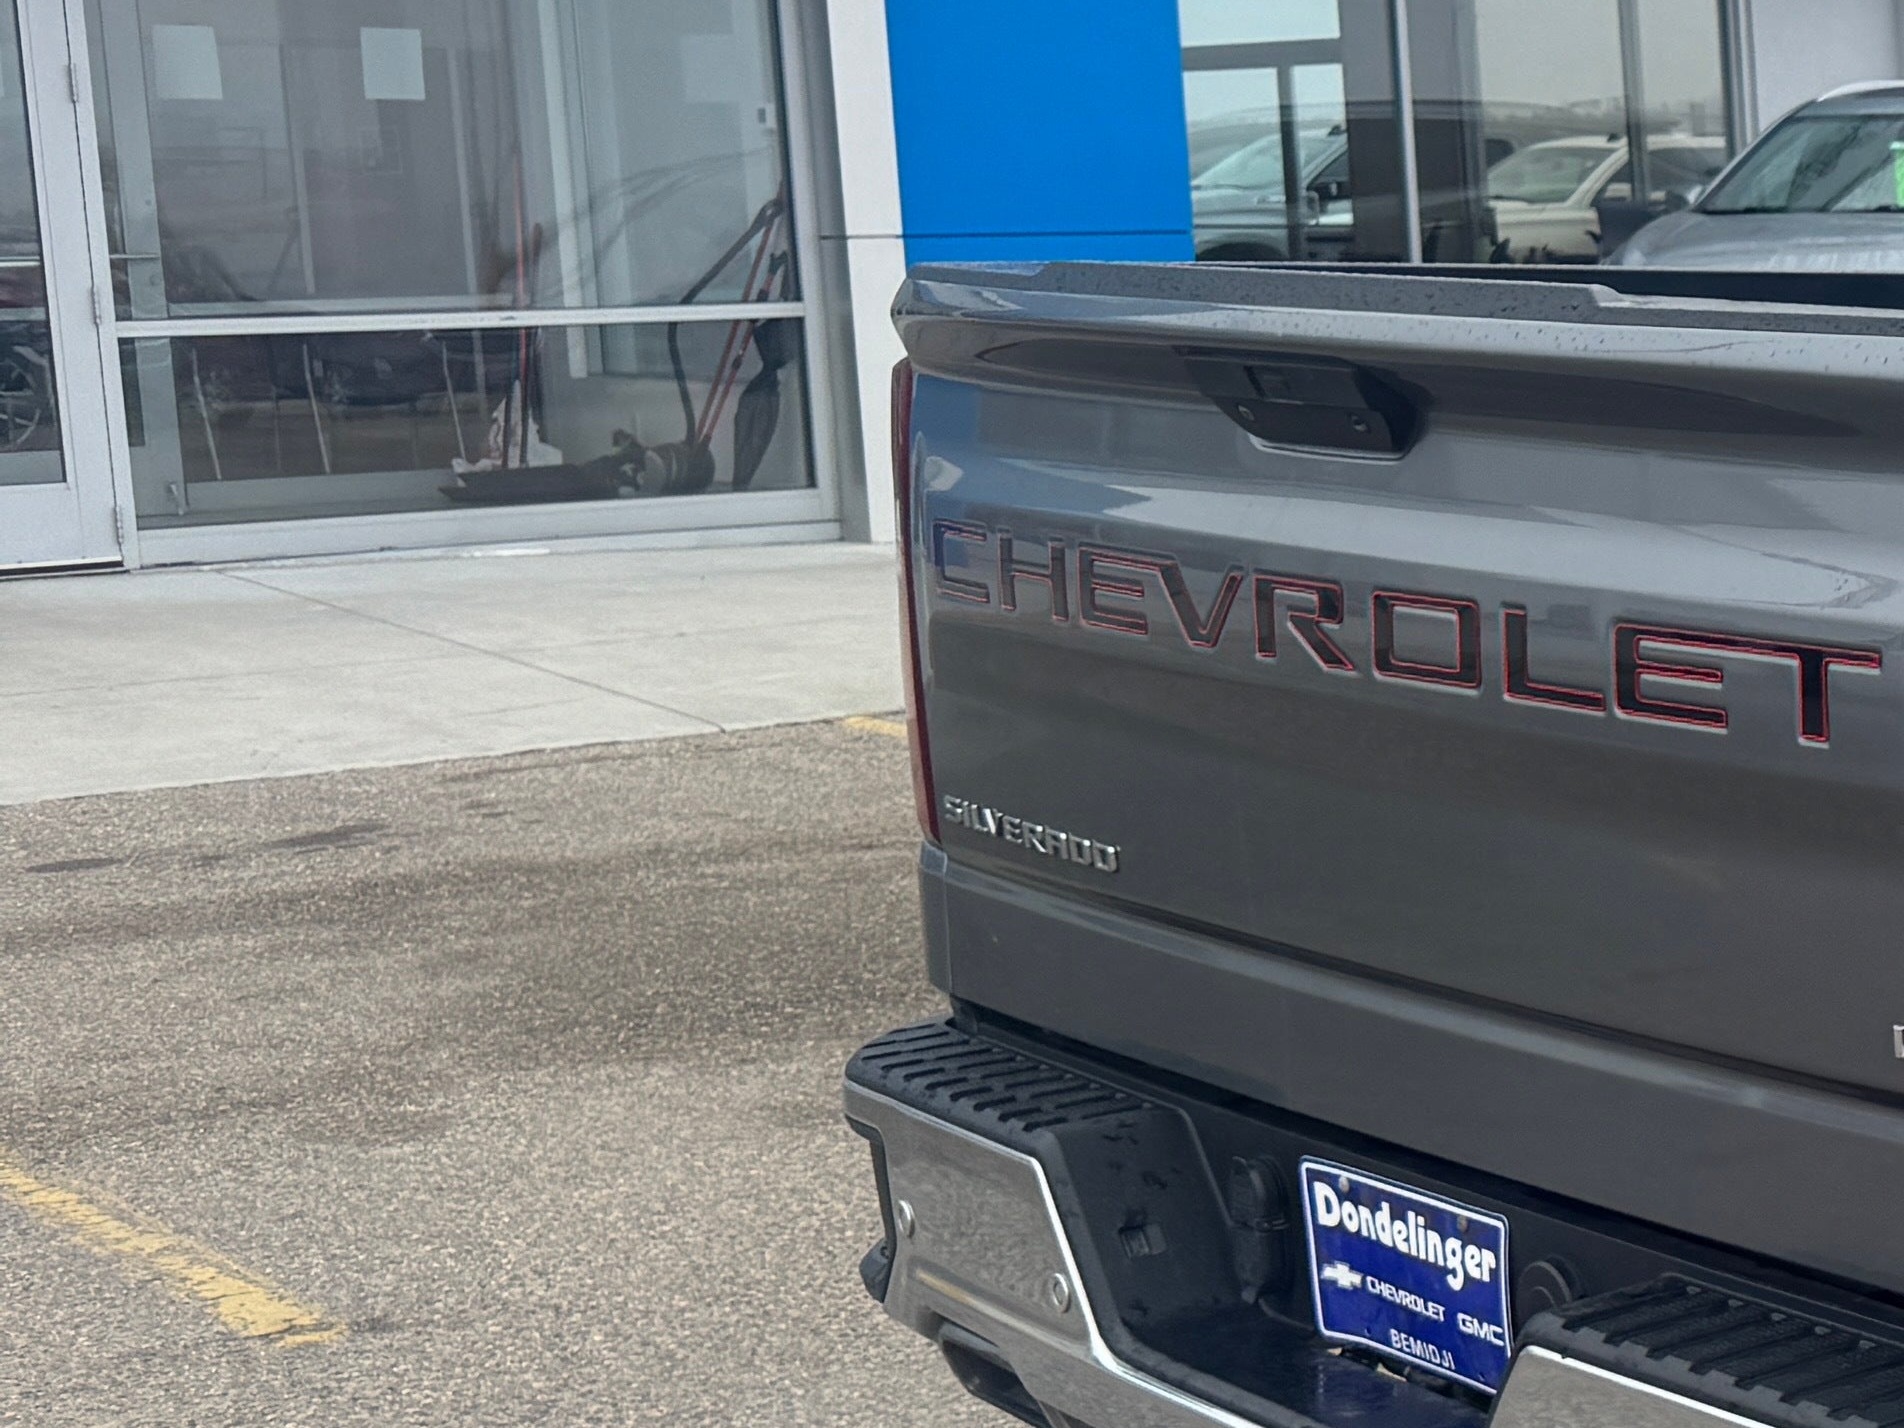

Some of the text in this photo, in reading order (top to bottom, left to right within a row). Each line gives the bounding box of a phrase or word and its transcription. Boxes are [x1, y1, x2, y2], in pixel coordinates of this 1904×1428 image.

[930, 518, 1882, 744] CHEVROLET
[943, 794, 1121, 873] SILVERADO
[1313, 1180, 1496, 1291] Dondelinger
[1366, 1276, 1504, 1346] CHEVROLET GMC
[1389, 1327, 1455, 1371] BEMIDJI
